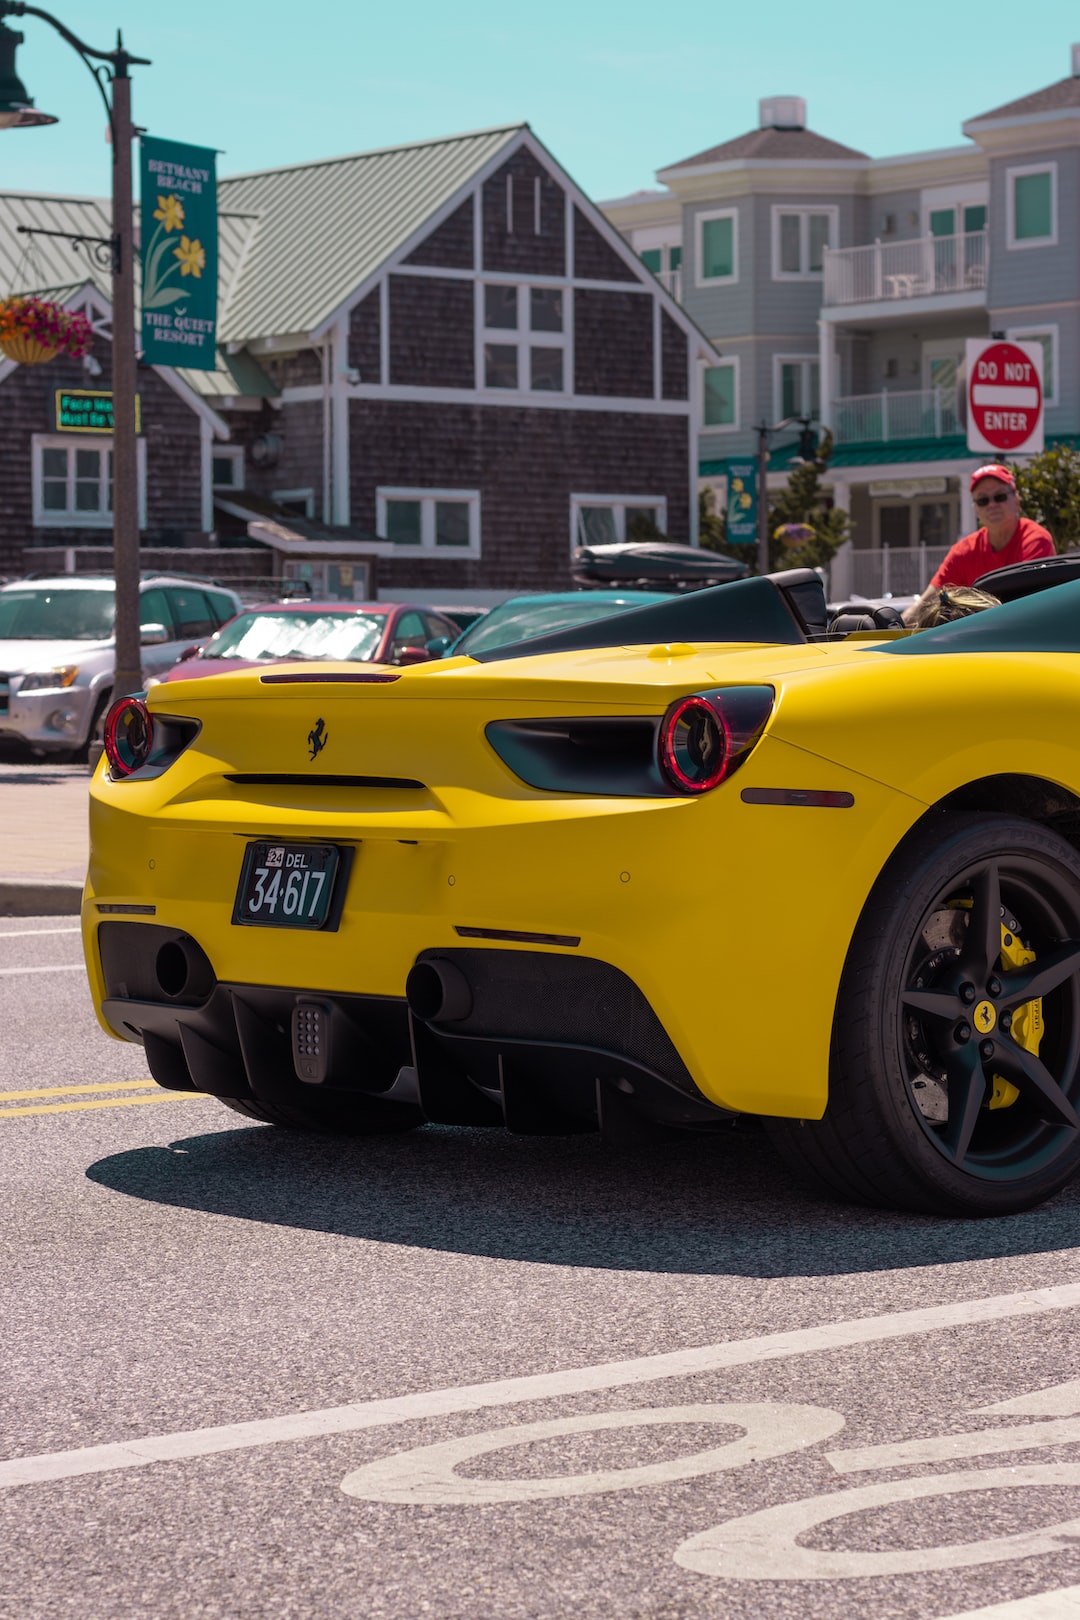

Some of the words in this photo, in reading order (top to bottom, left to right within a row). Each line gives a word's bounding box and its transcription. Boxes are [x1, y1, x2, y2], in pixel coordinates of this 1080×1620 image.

[148, 159, 209, 182] BETHANY
[157, 174, 202, 194] BEACH
[144, 312, 172, 327] THE
[174, 316, 214, 333] QUIET
[154, 328, 204, 347] RESORT
[978, 361, 997, 379] DO
[1004, 362, 1032, 382] NOT
[984, 411, 1028, 431] ENTER
